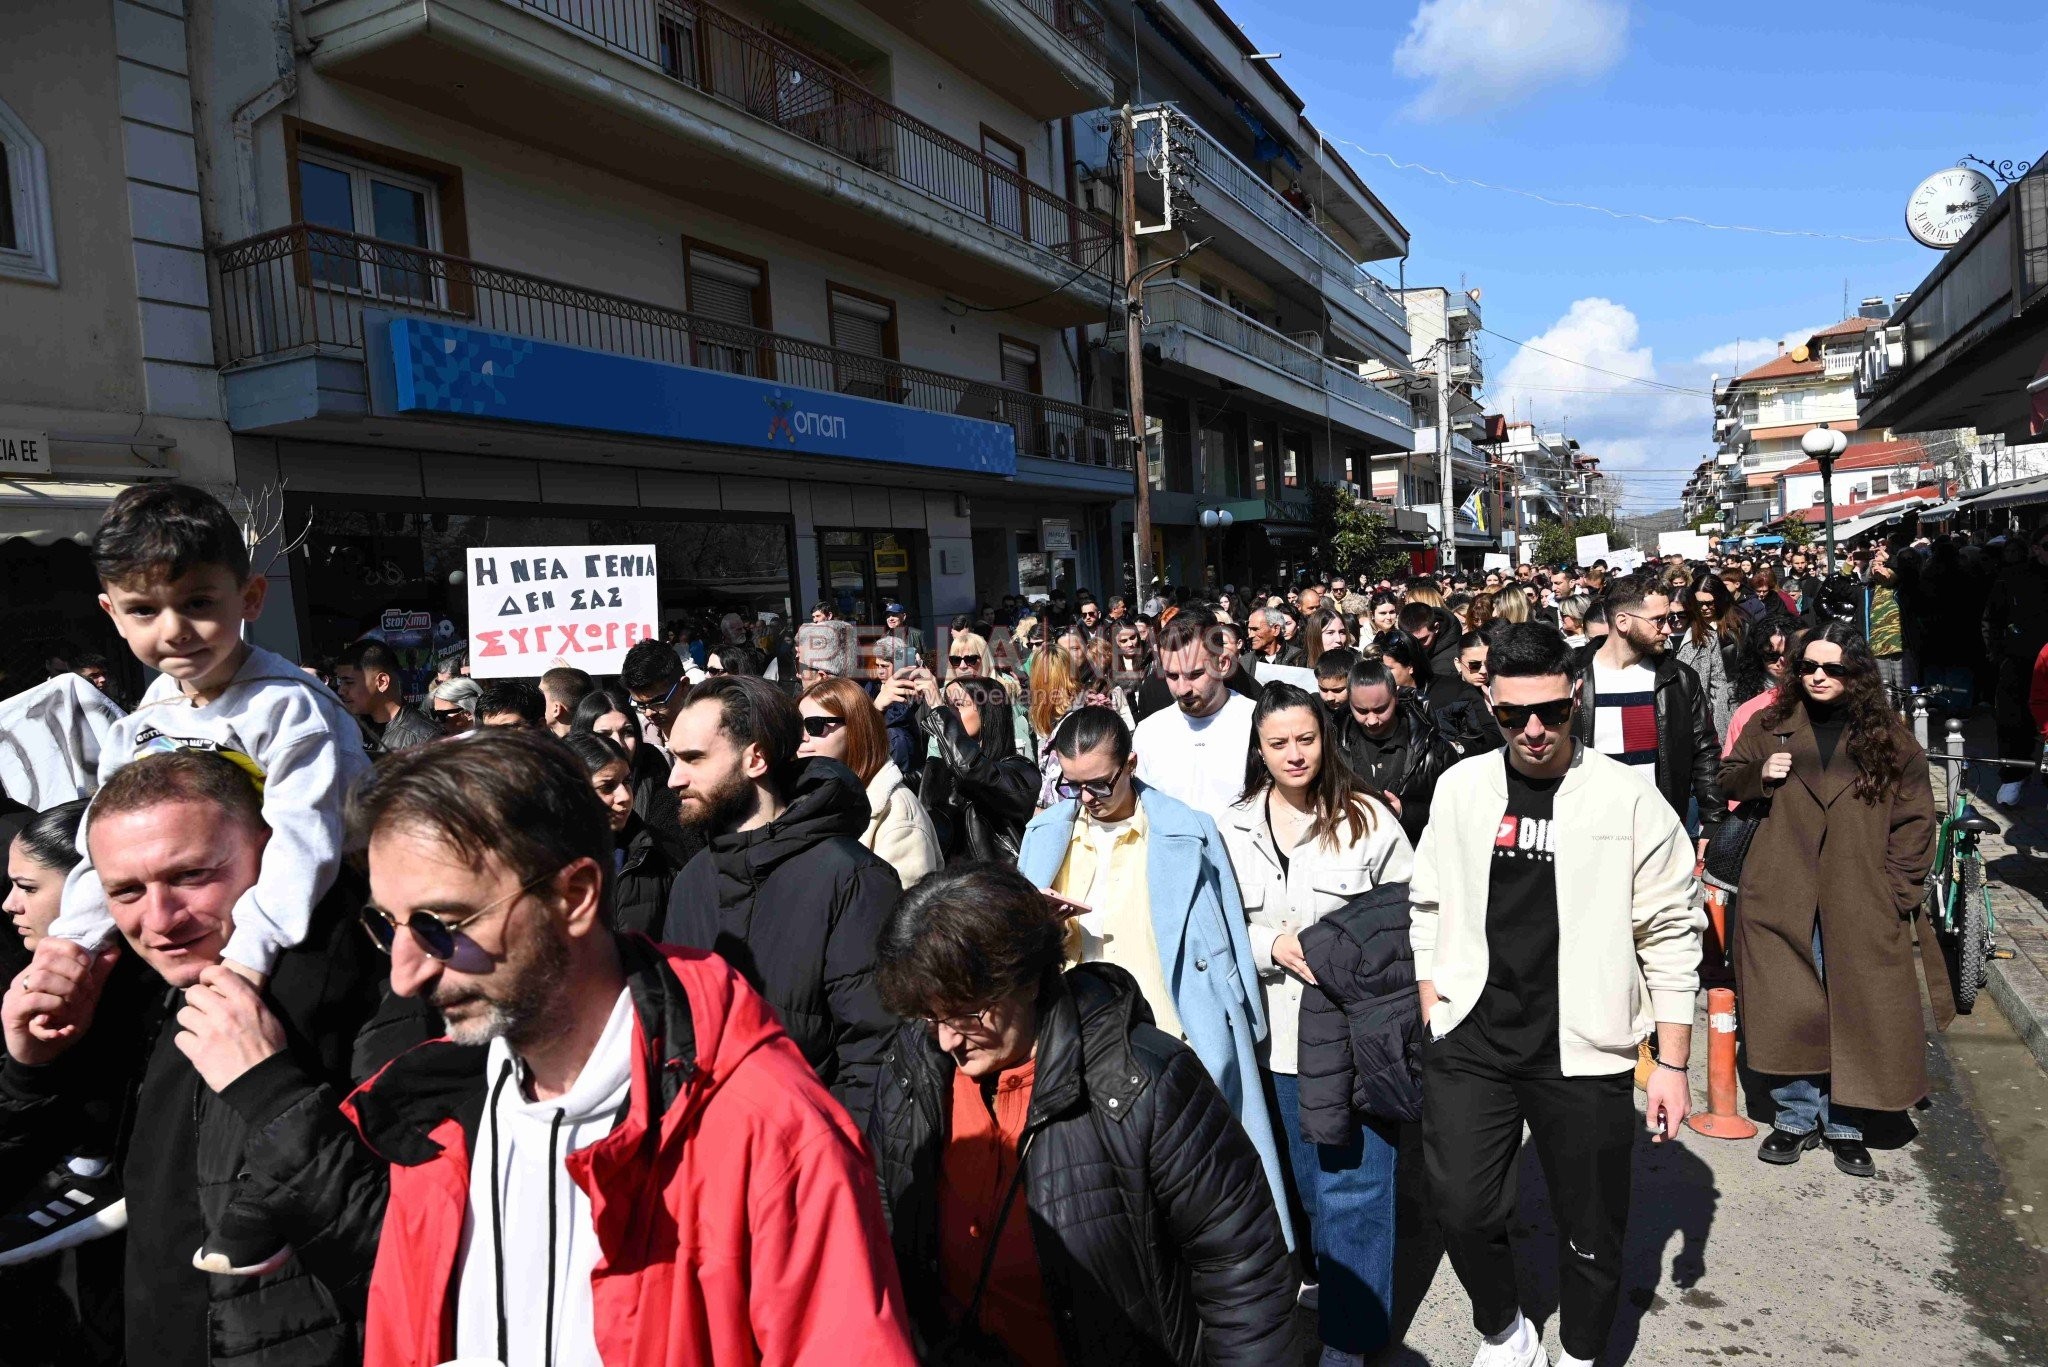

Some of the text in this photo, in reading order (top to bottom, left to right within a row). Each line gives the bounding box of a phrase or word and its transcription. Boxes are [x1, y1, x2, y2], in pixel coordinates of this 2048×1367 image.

[21, 439, 39, 462] ΕΕ
[475, 553, 655, 586] Η ΝΕΑ ΓΕΝΙΑ
[498, 587, 622, 617] ΔΕΝ ΣΑΣ
